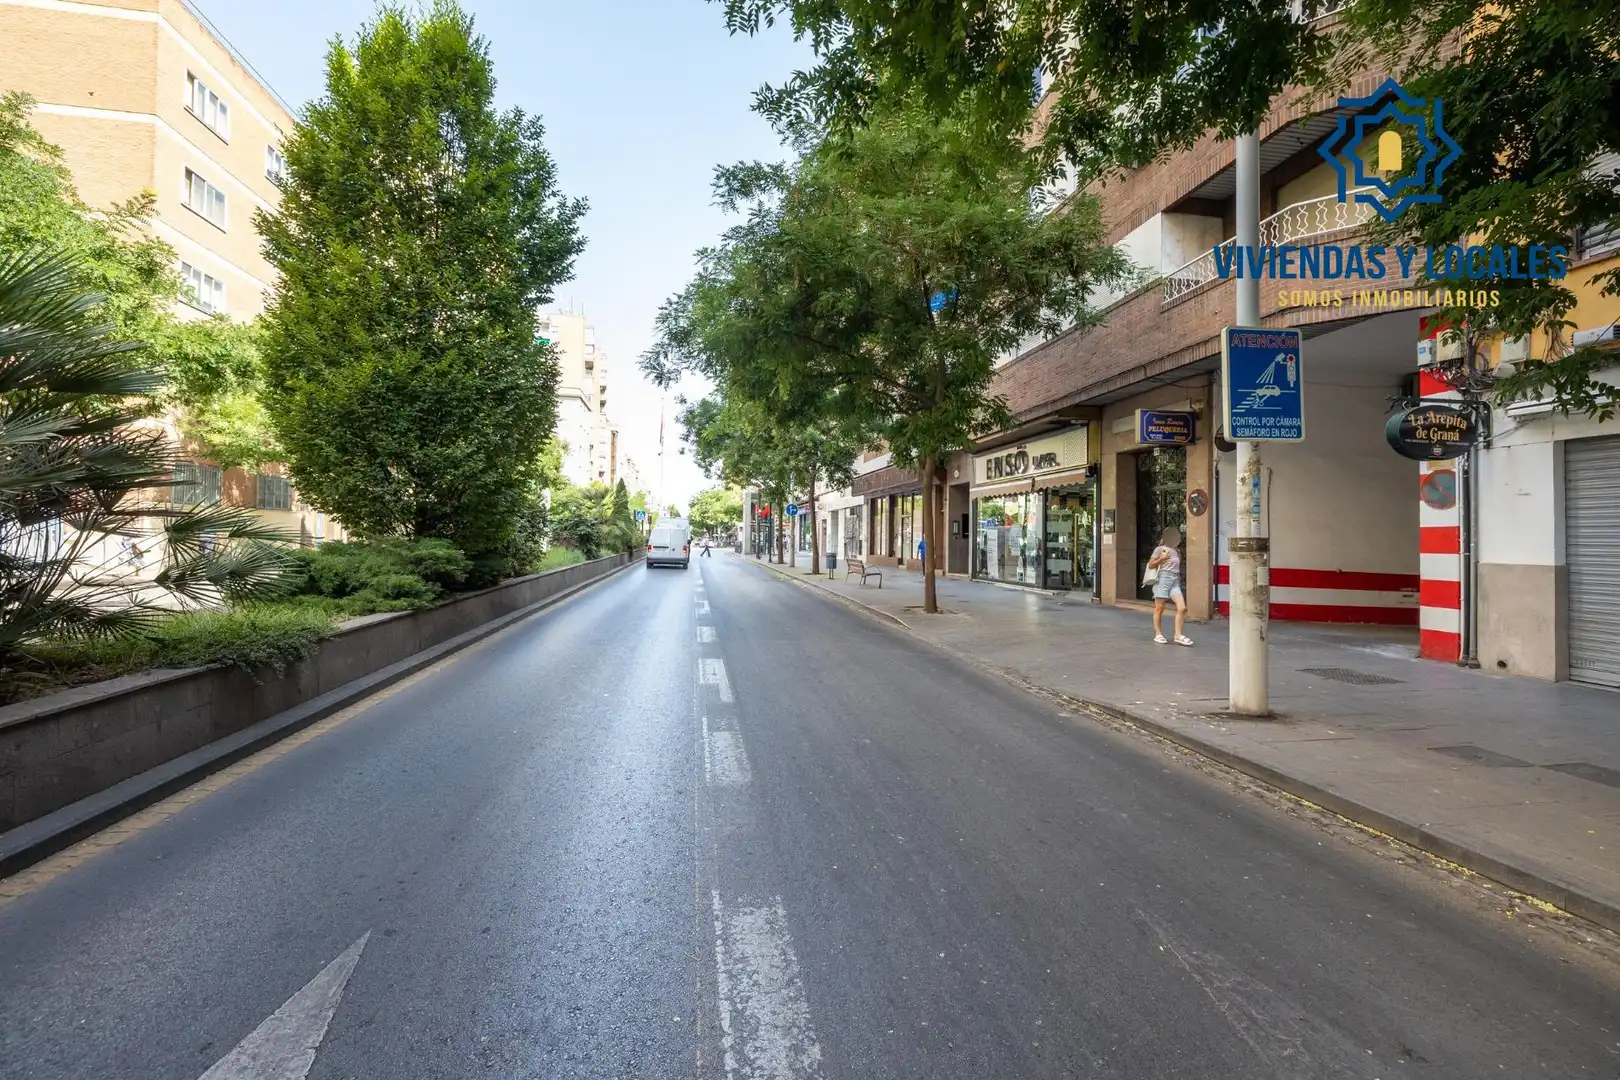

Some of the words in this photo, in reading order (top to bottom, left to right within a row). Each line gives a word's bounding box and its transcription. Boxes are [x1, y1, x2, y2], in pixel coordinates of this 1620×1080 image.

[1231, 332, 1298, 348] ATENCIÓN
[1232, 416, 1261, 426] CONTROL
[1262, 417, 1275, 426] POR
[1276, 415, 1301, 426] CÁMARA
[1408, 413, 1424, 426] La
[1425, 411, 1467, 430] Arepita
[1236, 427, 1270, 437] SEMÁFORO
[1271, 428, 1279, 437] EN
[1281, 428, 1298, 437] ROJO
[1416, 426, 1428, 439] de
[986, 450, 1029, 480] ENSO
